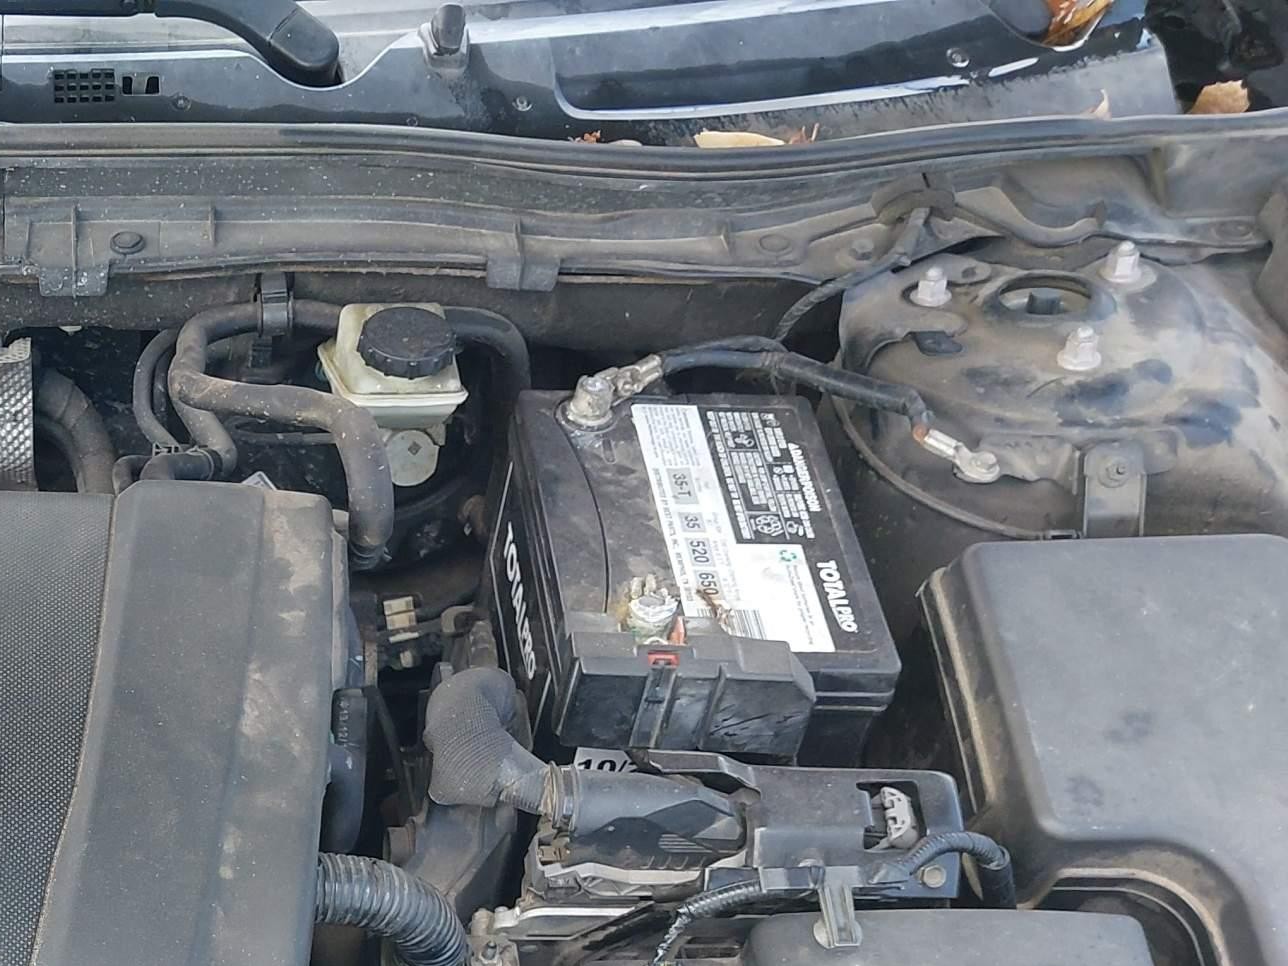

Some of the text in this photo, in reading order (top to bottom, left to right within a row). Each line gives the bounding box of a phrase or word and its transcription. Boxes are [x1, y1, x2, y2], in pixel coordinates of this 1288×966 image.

[672, 472, 692, 498] 35-T
[684, 515, 701, 529] 35
[689, 540, 710, 564] 520
[698, 572, 719, 596] 650
[817, 560, 858, 633] TOTALPRO
[504, 521, 536, 680] TOTALPRO
